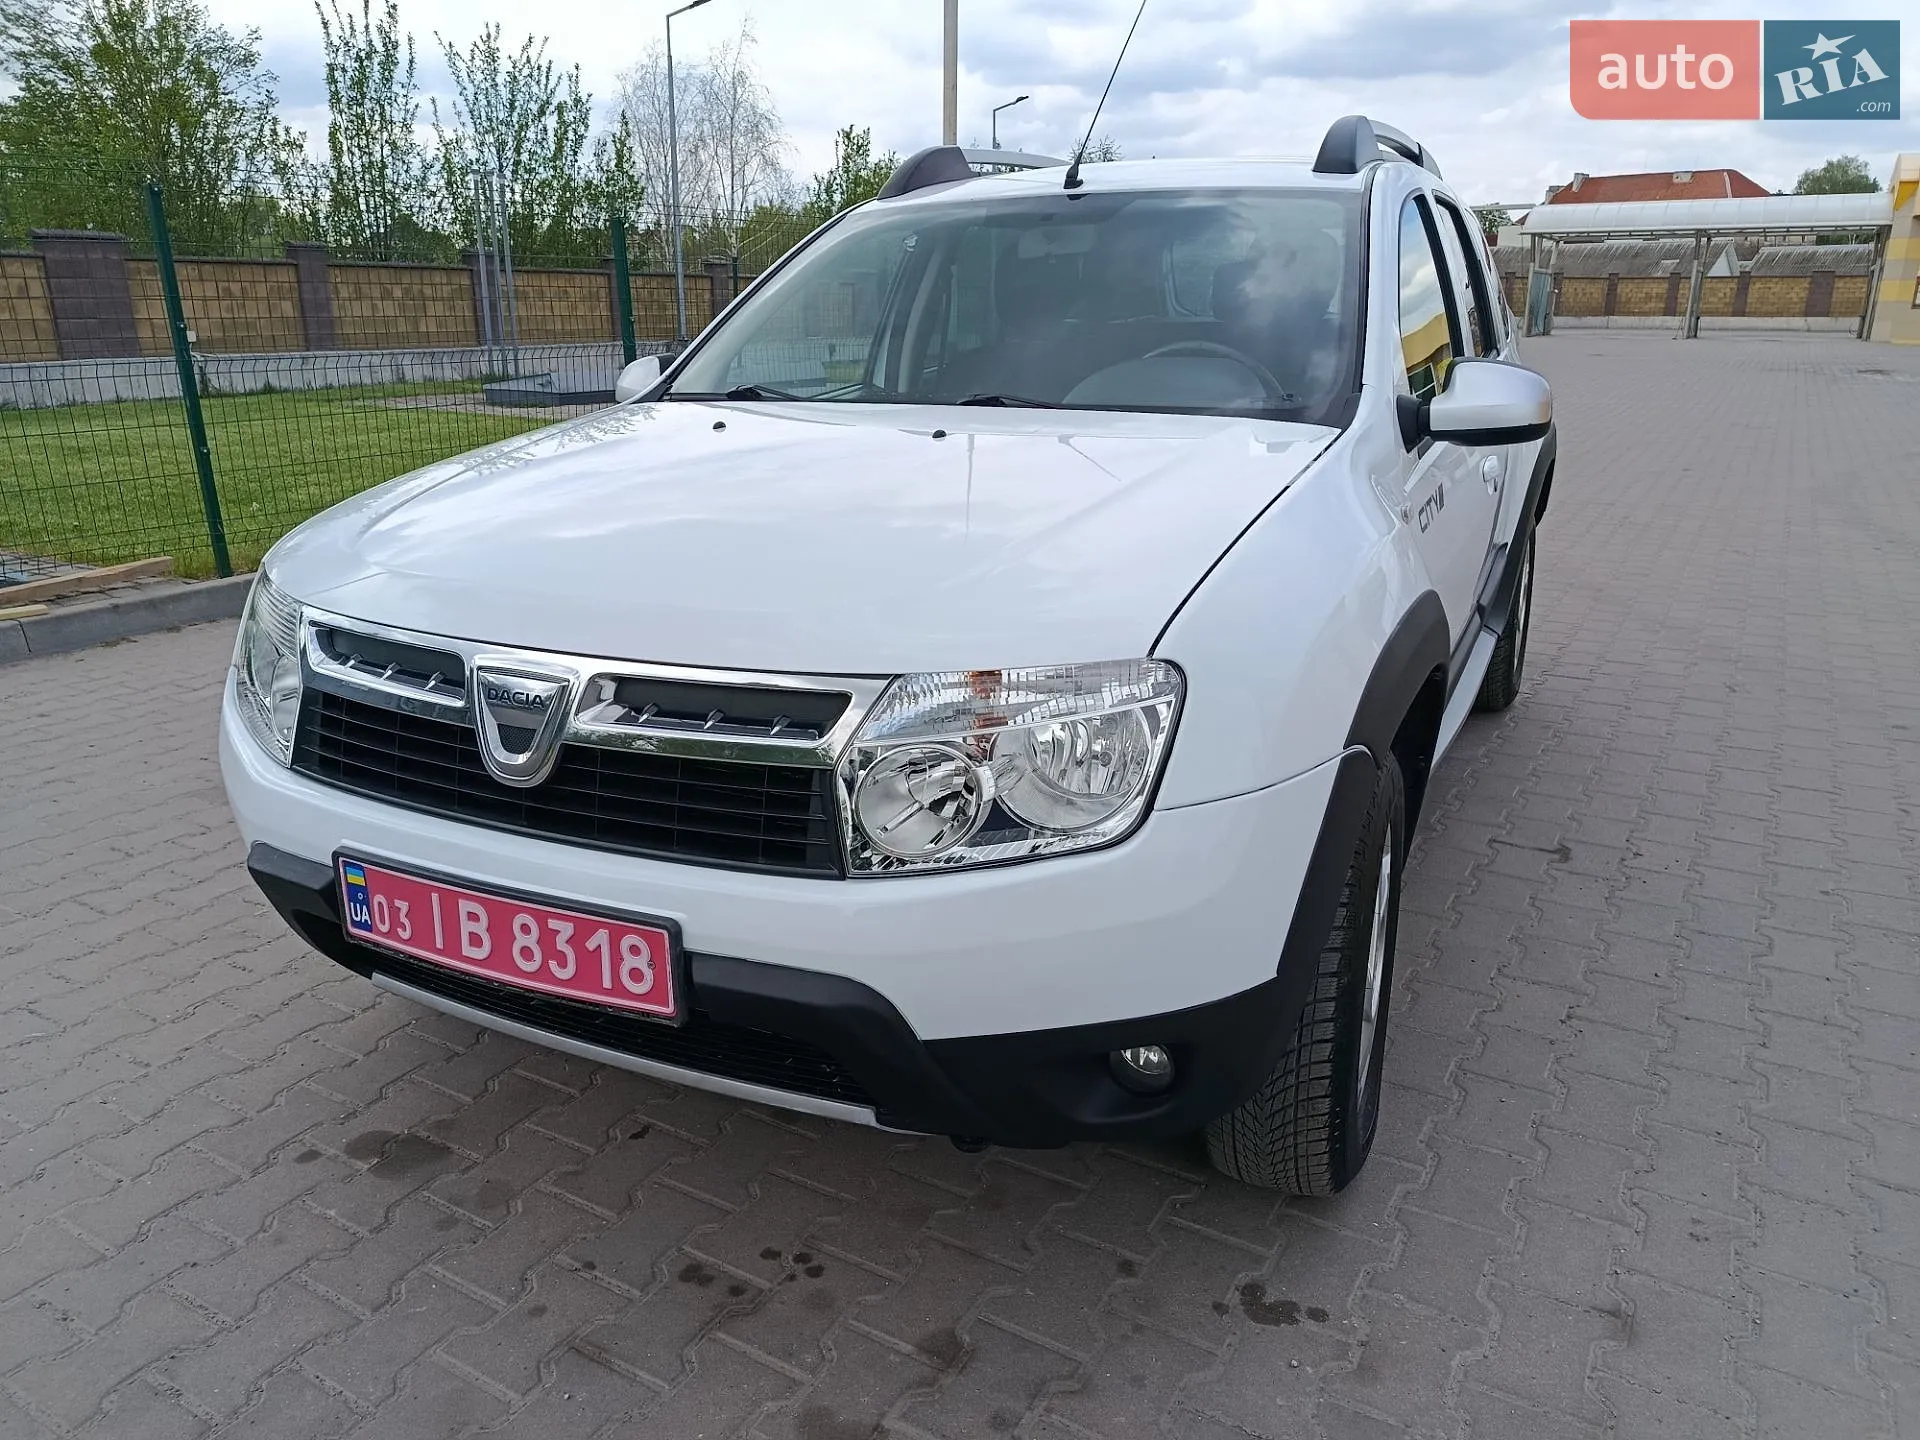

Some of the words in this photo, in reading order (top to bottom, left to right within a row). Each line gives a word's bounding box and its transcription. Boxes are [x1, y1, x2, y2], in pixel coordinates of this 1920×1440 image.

[487, 688, 545, 708] DACIA
[350, 902, 372, 925] UA
[373, 894, 412, 941] 03
[511, 912, 655, 996] 8318
